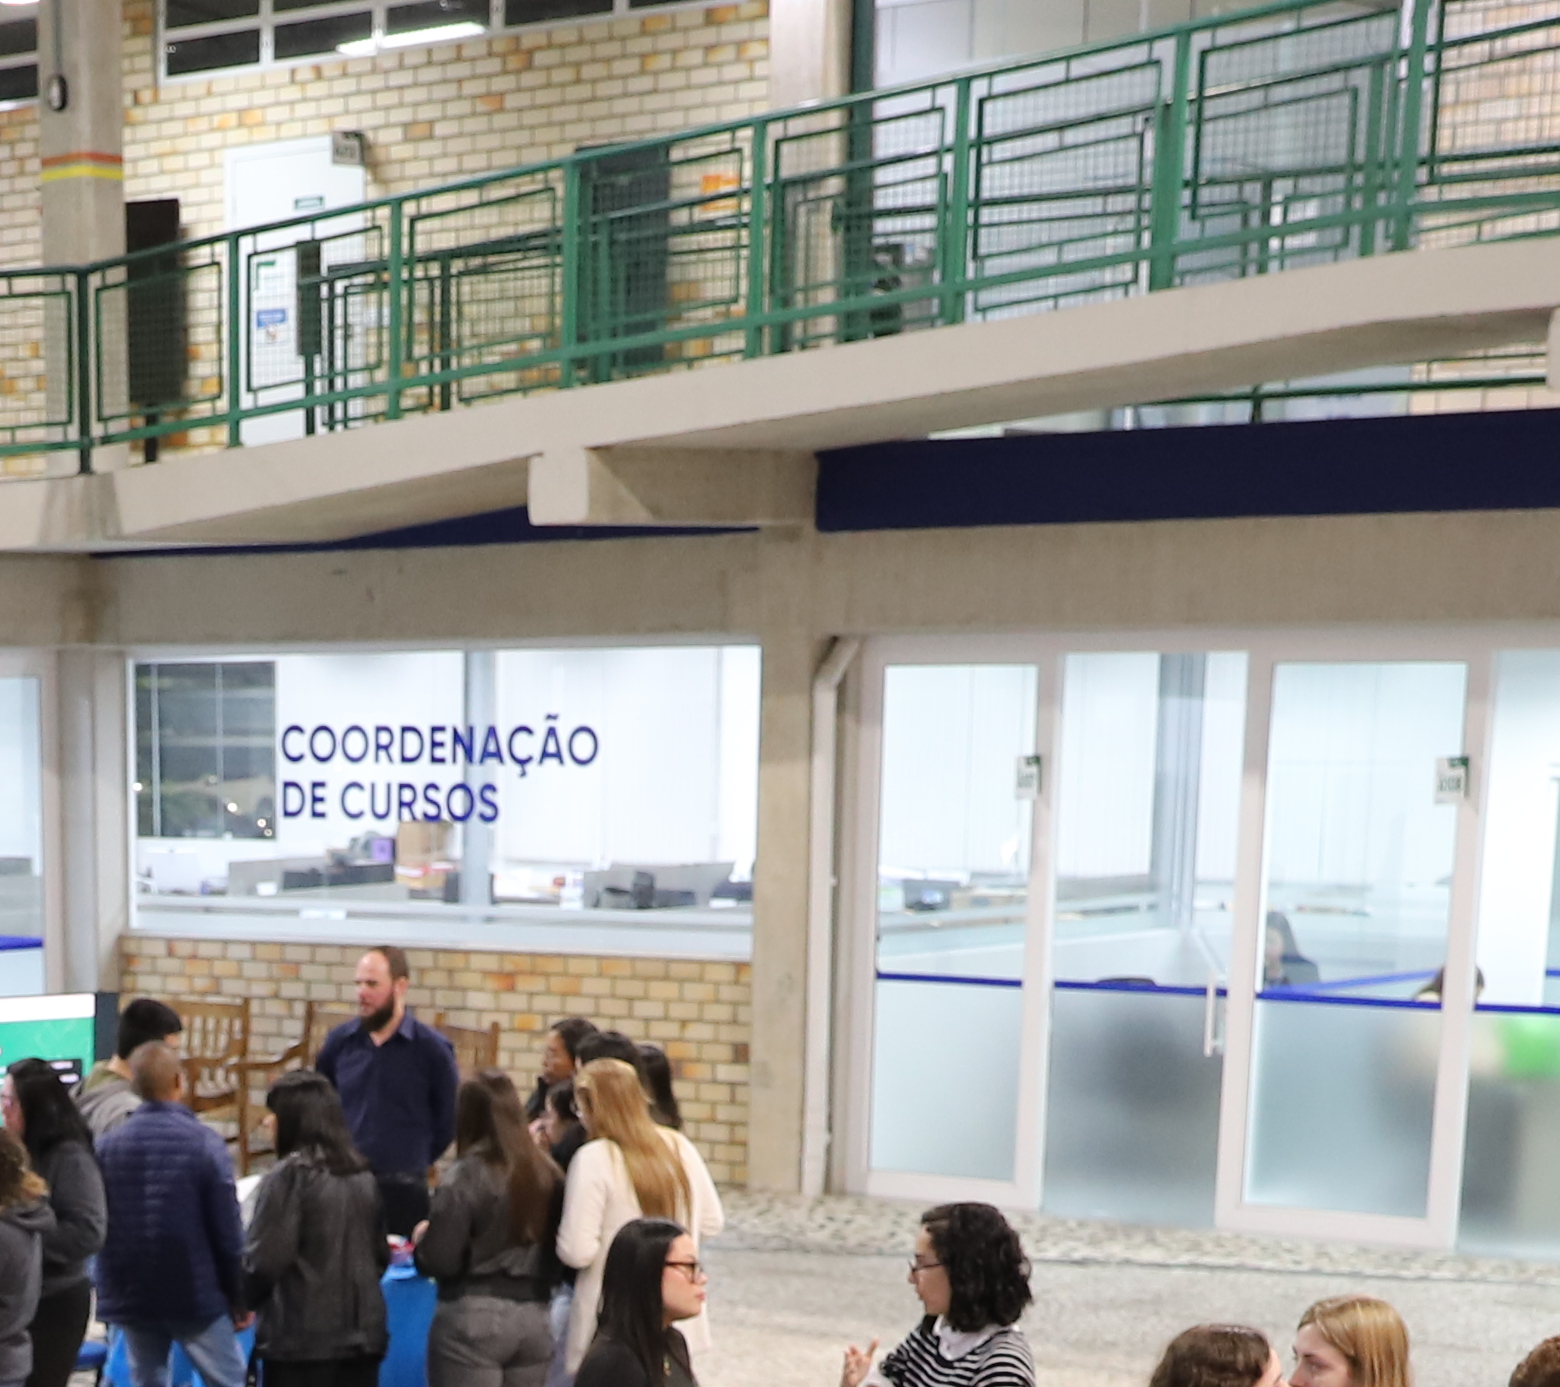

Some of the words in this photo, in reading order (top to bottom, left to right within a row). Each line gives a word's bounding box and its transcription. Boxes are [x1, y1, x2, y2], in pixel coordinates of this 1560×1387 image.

[281, 713, 599, 778] COORDENAÇÃO
[282, 781, 327, 819] DE
[340, 782, 499, 823] CURSOS
